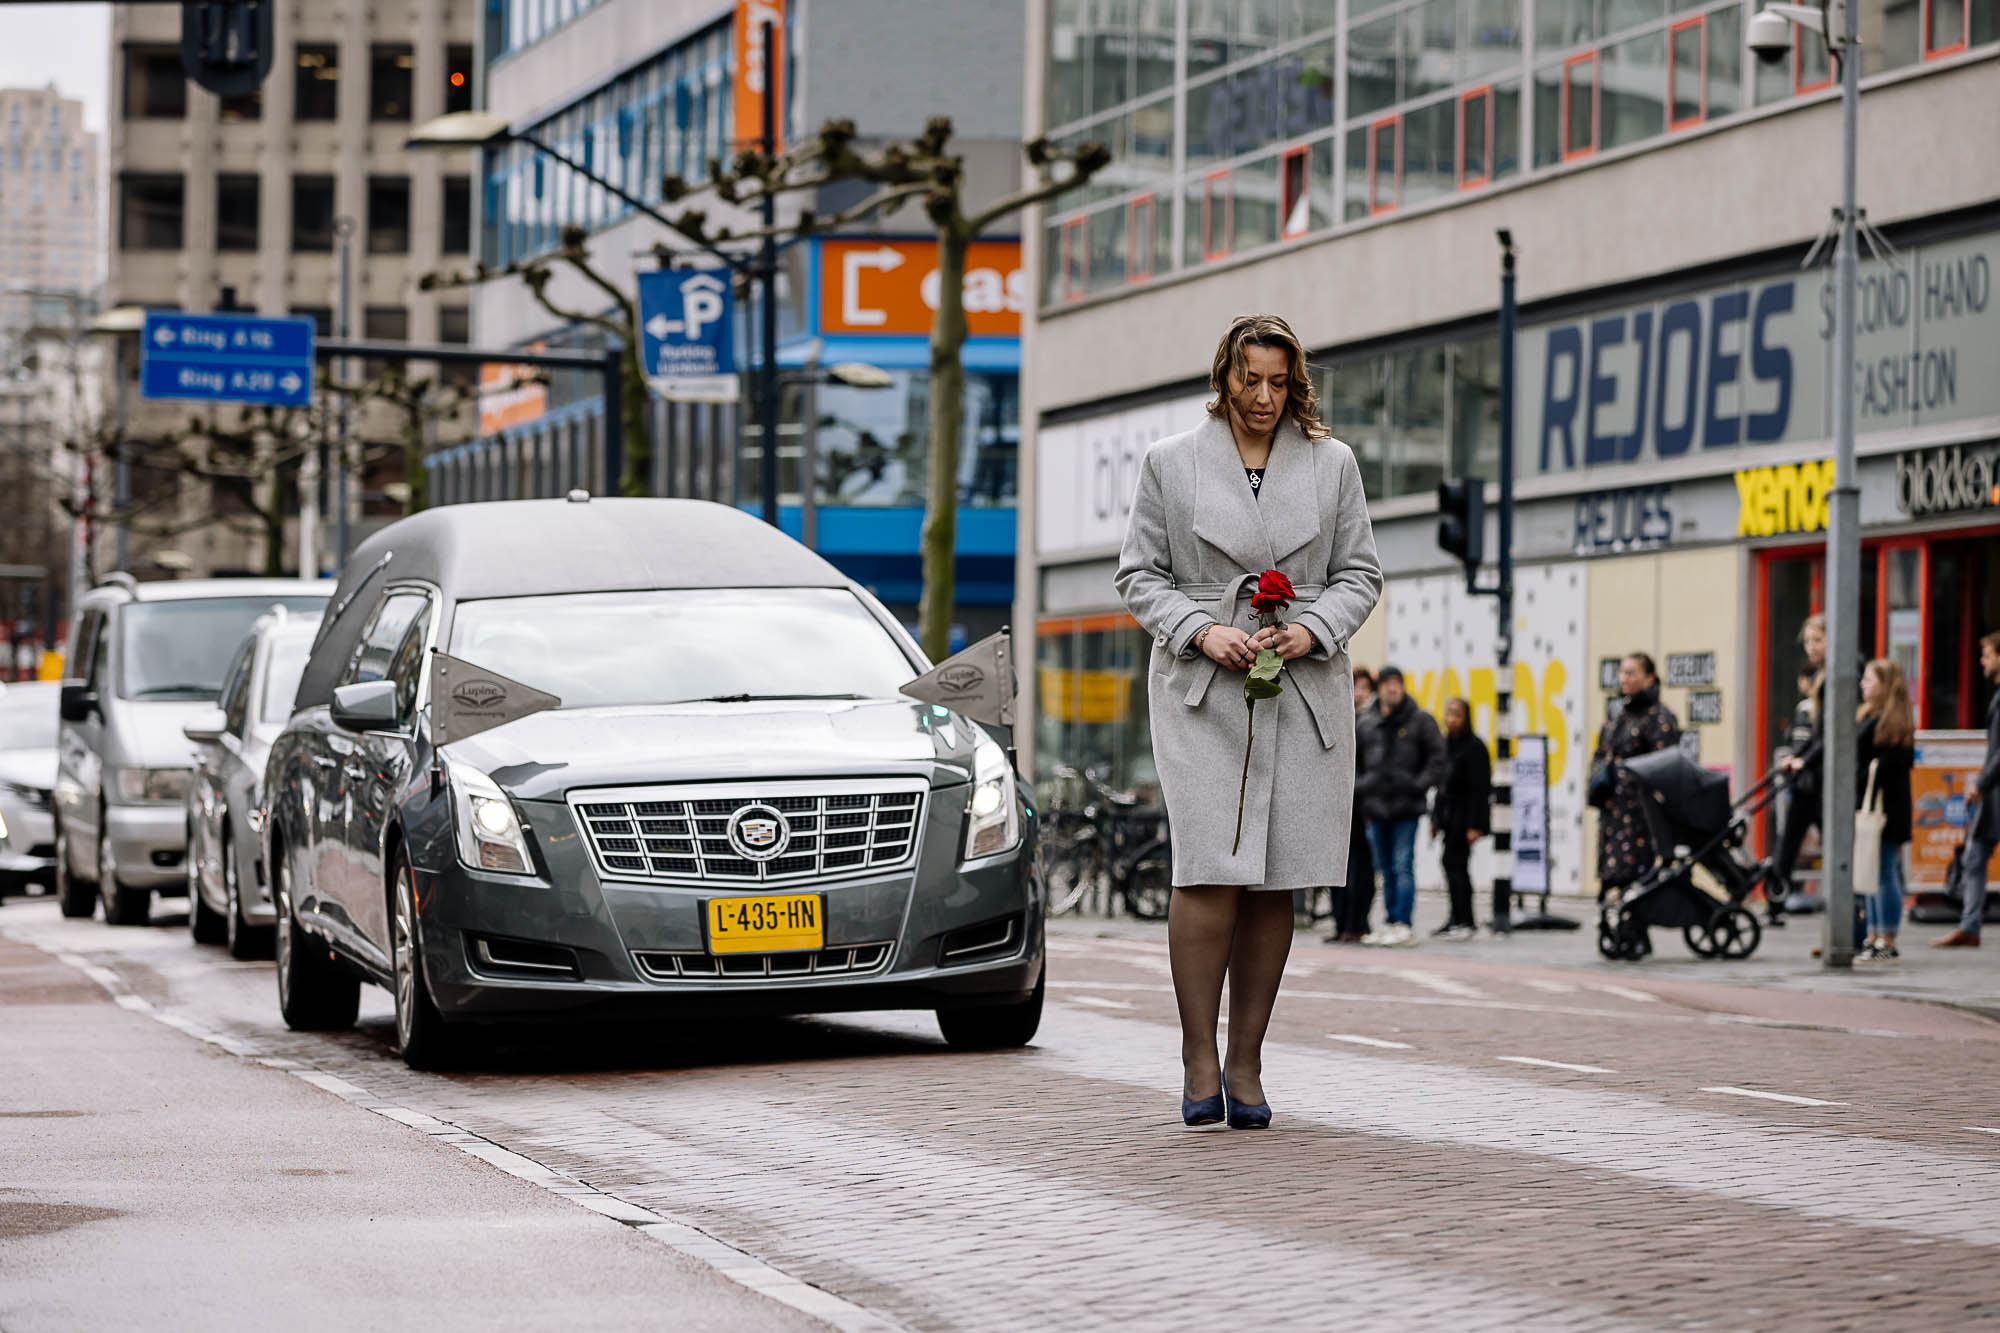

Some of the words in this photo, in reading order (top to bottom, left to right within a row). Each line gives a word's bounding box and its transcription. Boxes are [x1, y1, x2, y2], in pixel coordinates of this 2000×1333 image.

[1818, 268, 1911, 340] SOND
[1923, 252, 1990, 322] HAND
[181, 326, 226, 350] Ring
[179, 368, 225, 393] Ring
[1539, 281, 1795, 472] REJOES
[1857, 348, 1957, 418] ASHION
[717, 900, 815, 932] L-435-HN
